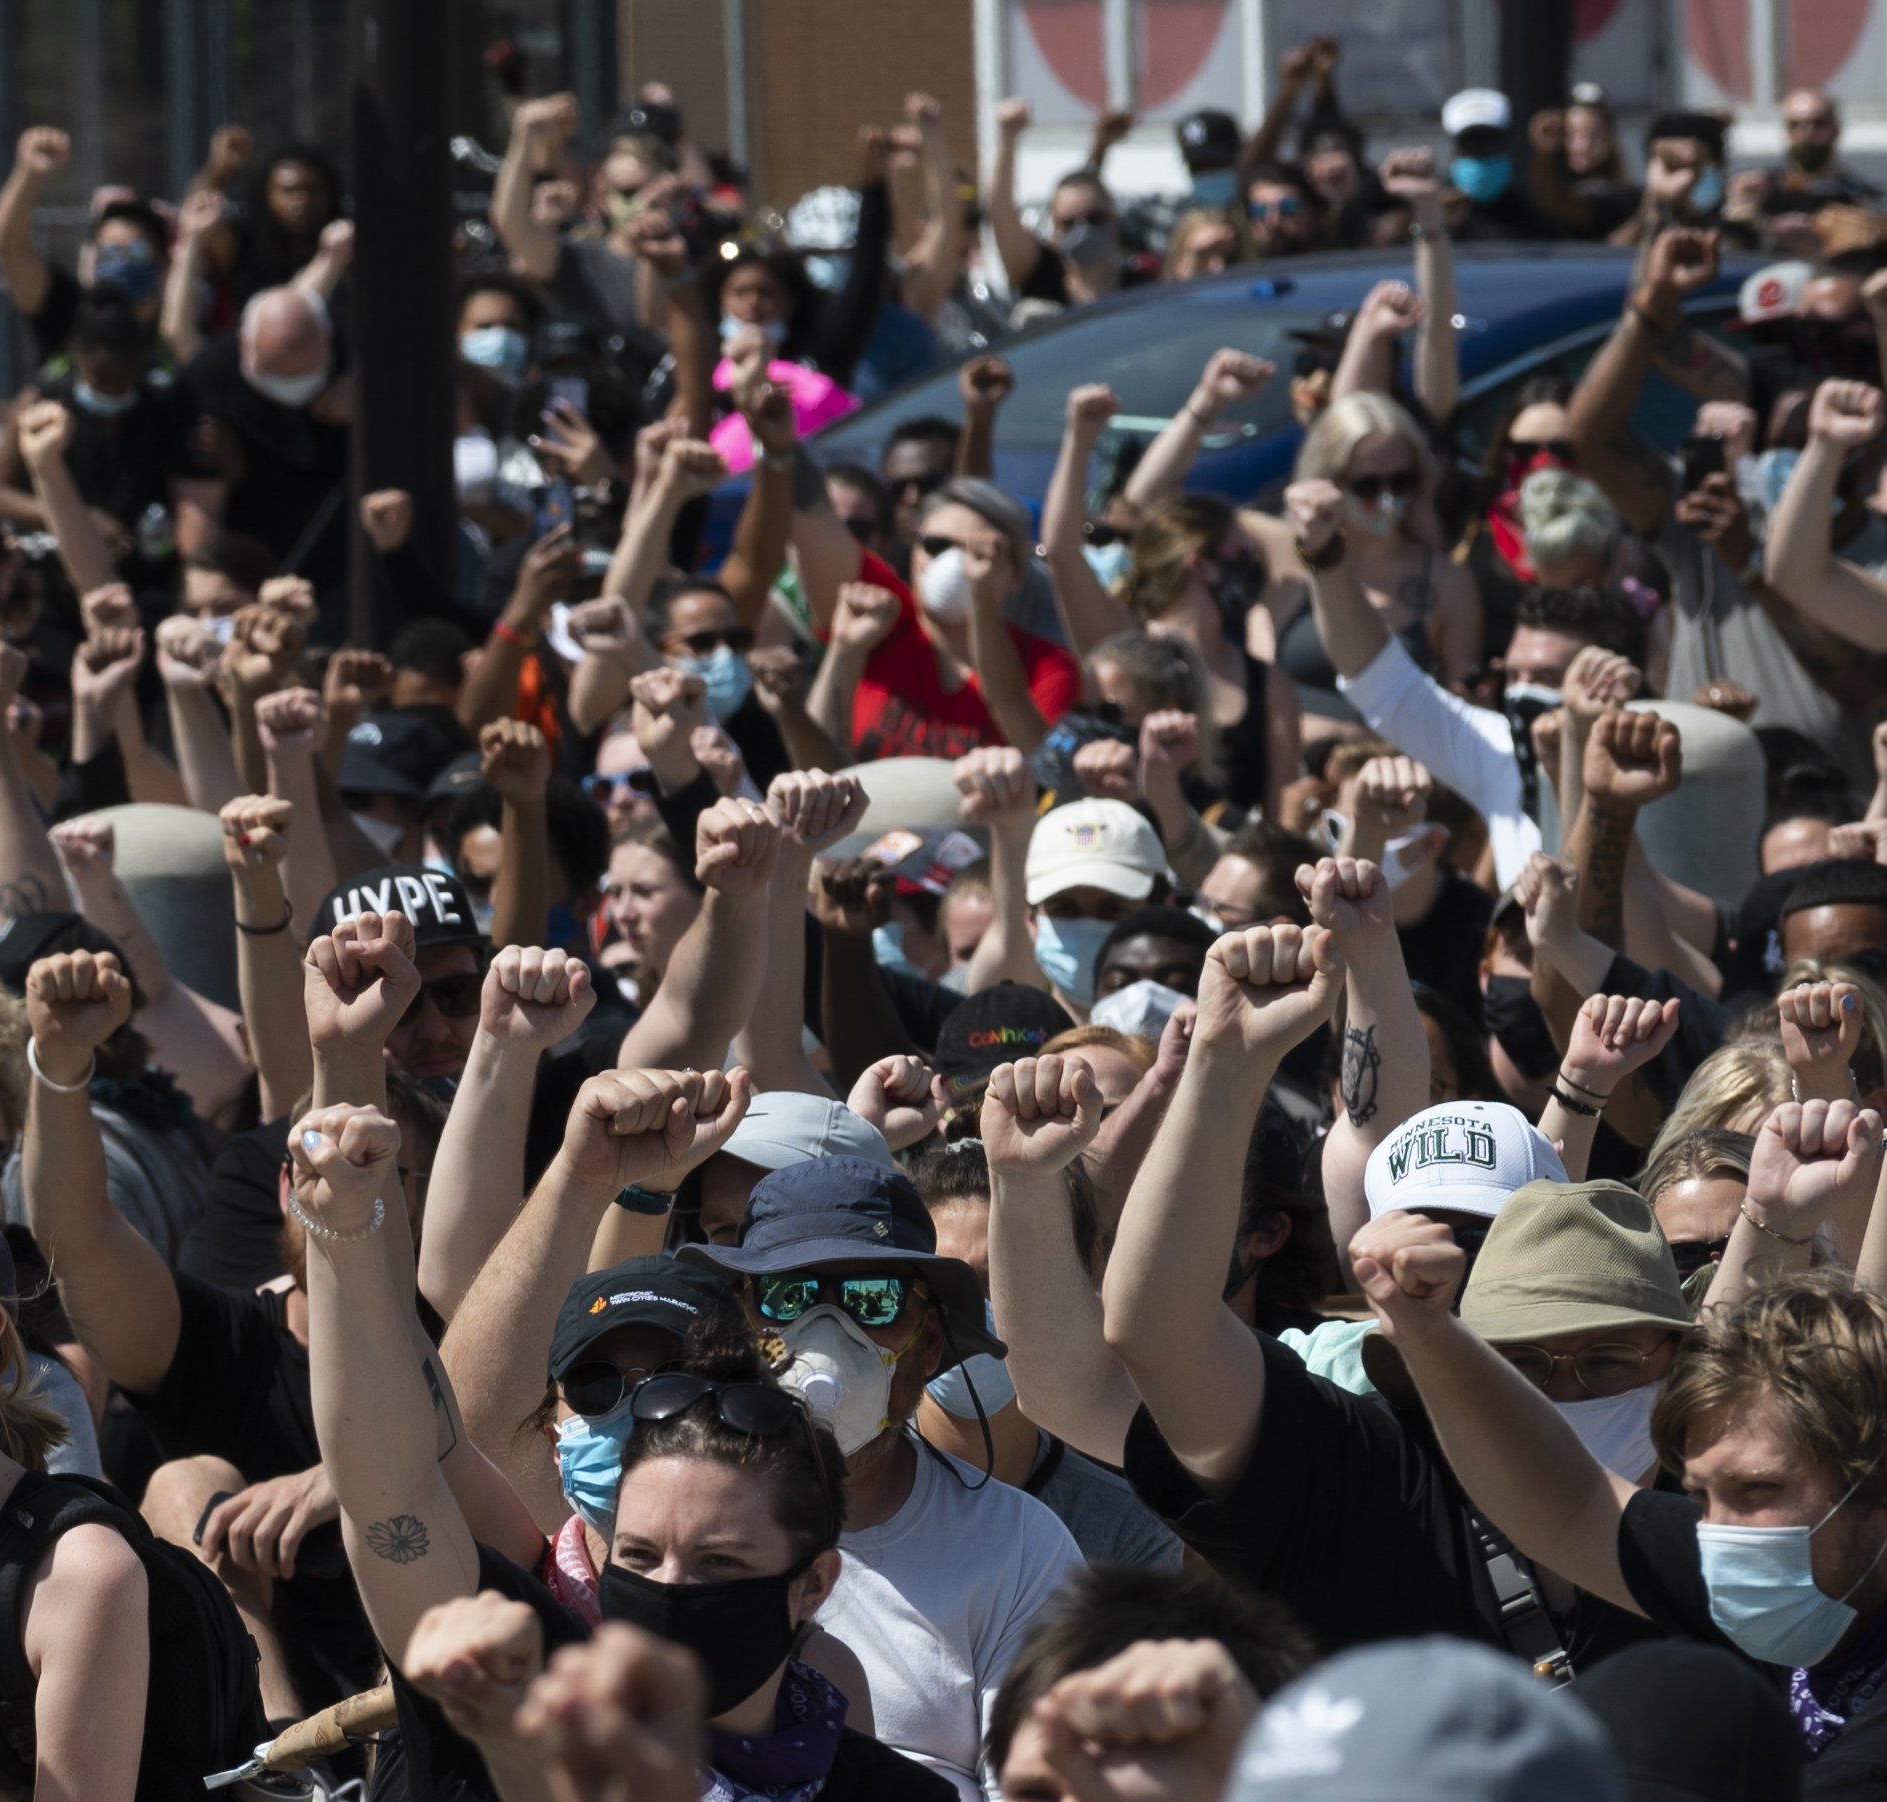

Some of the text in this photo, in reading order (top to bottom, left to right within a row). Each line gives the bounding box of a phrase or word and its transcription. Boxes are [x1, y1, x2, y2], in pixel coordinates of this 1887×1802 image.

[332, 873, 461, 926] HYPE
[1388, 1127, 1496, 1185] WILD
[1391, 1116, 1493, 1150] MINNESOTA
